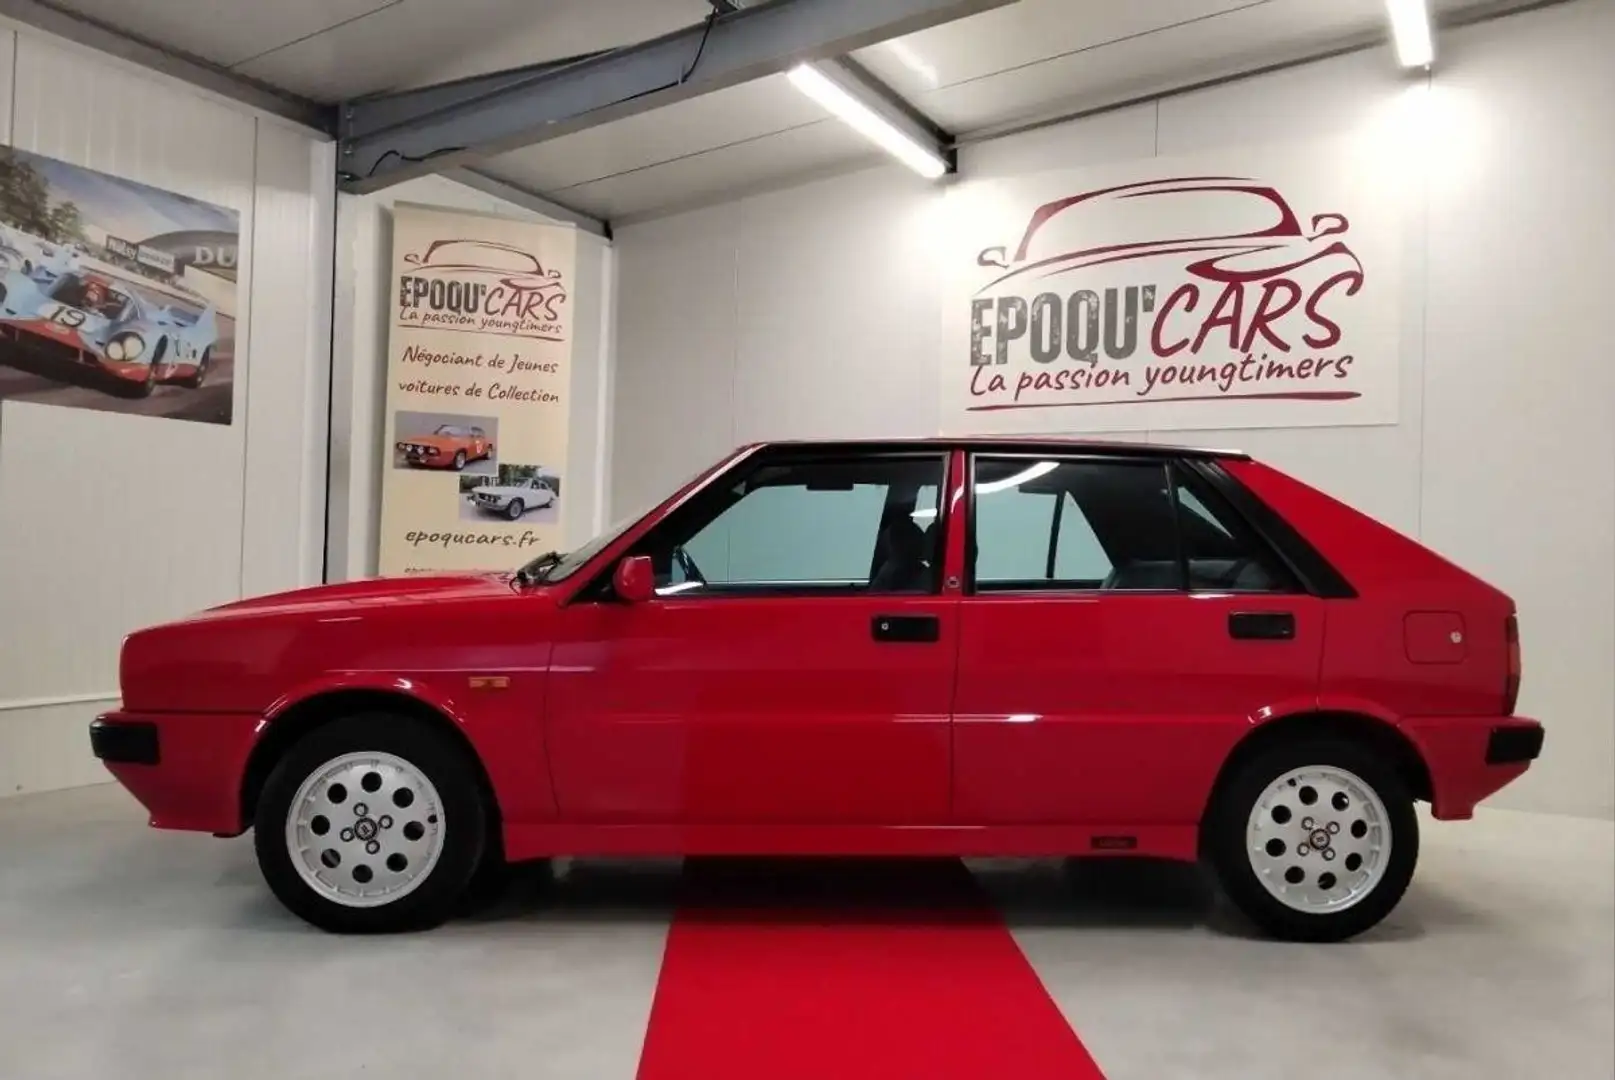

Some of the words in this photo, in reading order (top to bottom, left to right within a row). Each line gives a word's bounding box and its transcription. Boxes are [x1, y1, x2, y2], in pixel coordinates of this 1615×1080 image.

[51, 305, 86, 328] 19
[400, 303, 418, 321] La
[423, 312, 476, 328] passion
[481, 315, 563, 334] youngtimers
[402, 345, 483, 369] Négociant
[488, 353, 505, 369] de
[507, 353, 559, 374] Jeunes
[970, 363, 1007, 397] La
[1015, 361, 1130, 402] passion
[1137, 352, 1354, 397] youngtimers
[399, 380, 461, 397] voitures
[465, 382, 483, 398] de
[488, 382, 560, 403] Collection
[405, 529, 541, 548] epoqucars.fr
